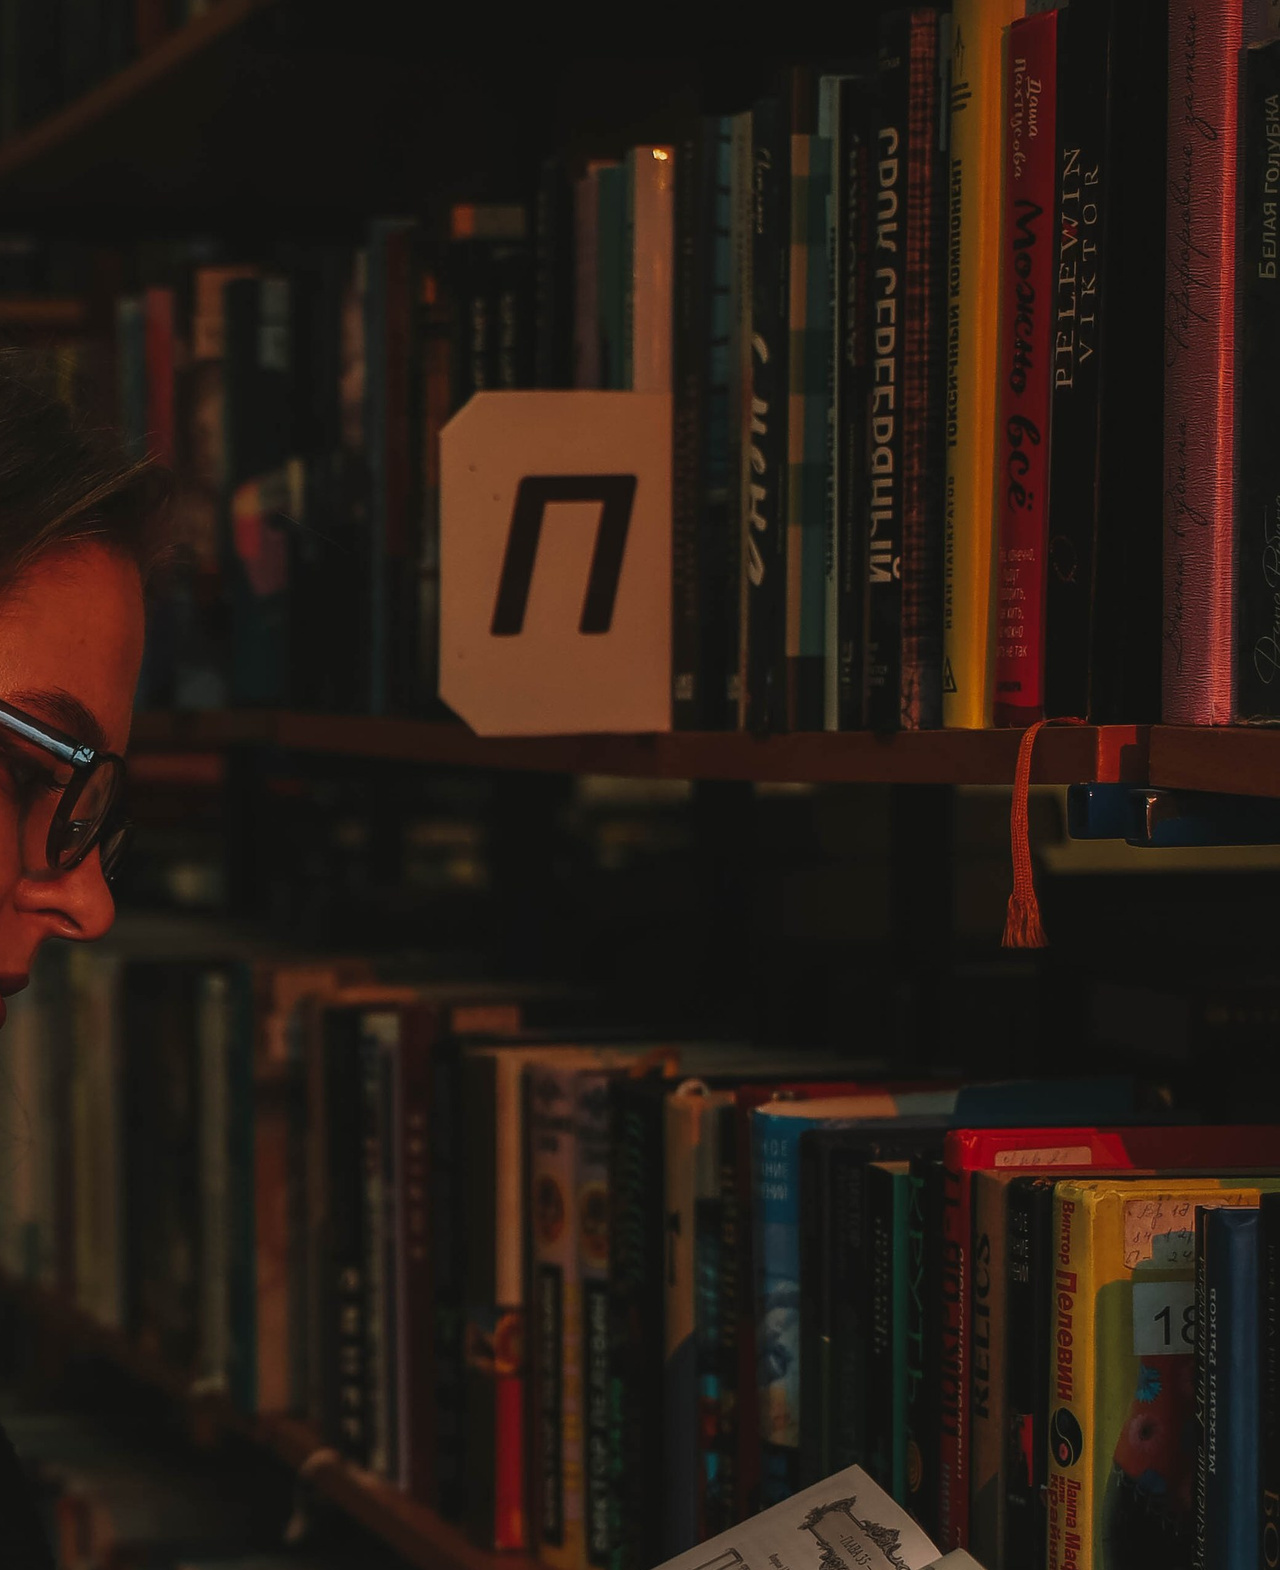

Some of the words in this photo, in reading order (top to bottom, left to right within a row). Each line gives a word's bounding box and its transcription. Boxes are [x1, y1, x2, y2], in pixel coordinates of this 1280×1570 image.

[1028, 76, 1042, 140] Даша
[1261, 94, 1280, 193] ГОЛУБКА
[949, 159, 962, 297] КОМПОНЕНТ
[1055, 145, 1082, 388] PELEWIN
[1079, 163, 1099, 366] VIKTOR
[1257, 202, 1278, 279] БЕЛАЯ
[1008, 199, 1043, 394] Можно
[947, 303, 961, 447] ТОКСИЧНЫЙ
[491, 475, 636, 637] П
[908, 1175, 925, 1404] КРУТЬ
[1061, 1201, 1075, 1265] Виктор
[973, 1233, 991, 1420] RELICS
[1055, 1269, 1078, 1402] Пелевин
[1208, 1287, 1217, 1366] Рыков
[1207, 1374, 1217, 1476] Михаил
[842, 1535, 860, 1557] ГЛАВА
[1058, 1475, 1067, 1503] или
[1066, 1478, 1081, 1528] Лампа
